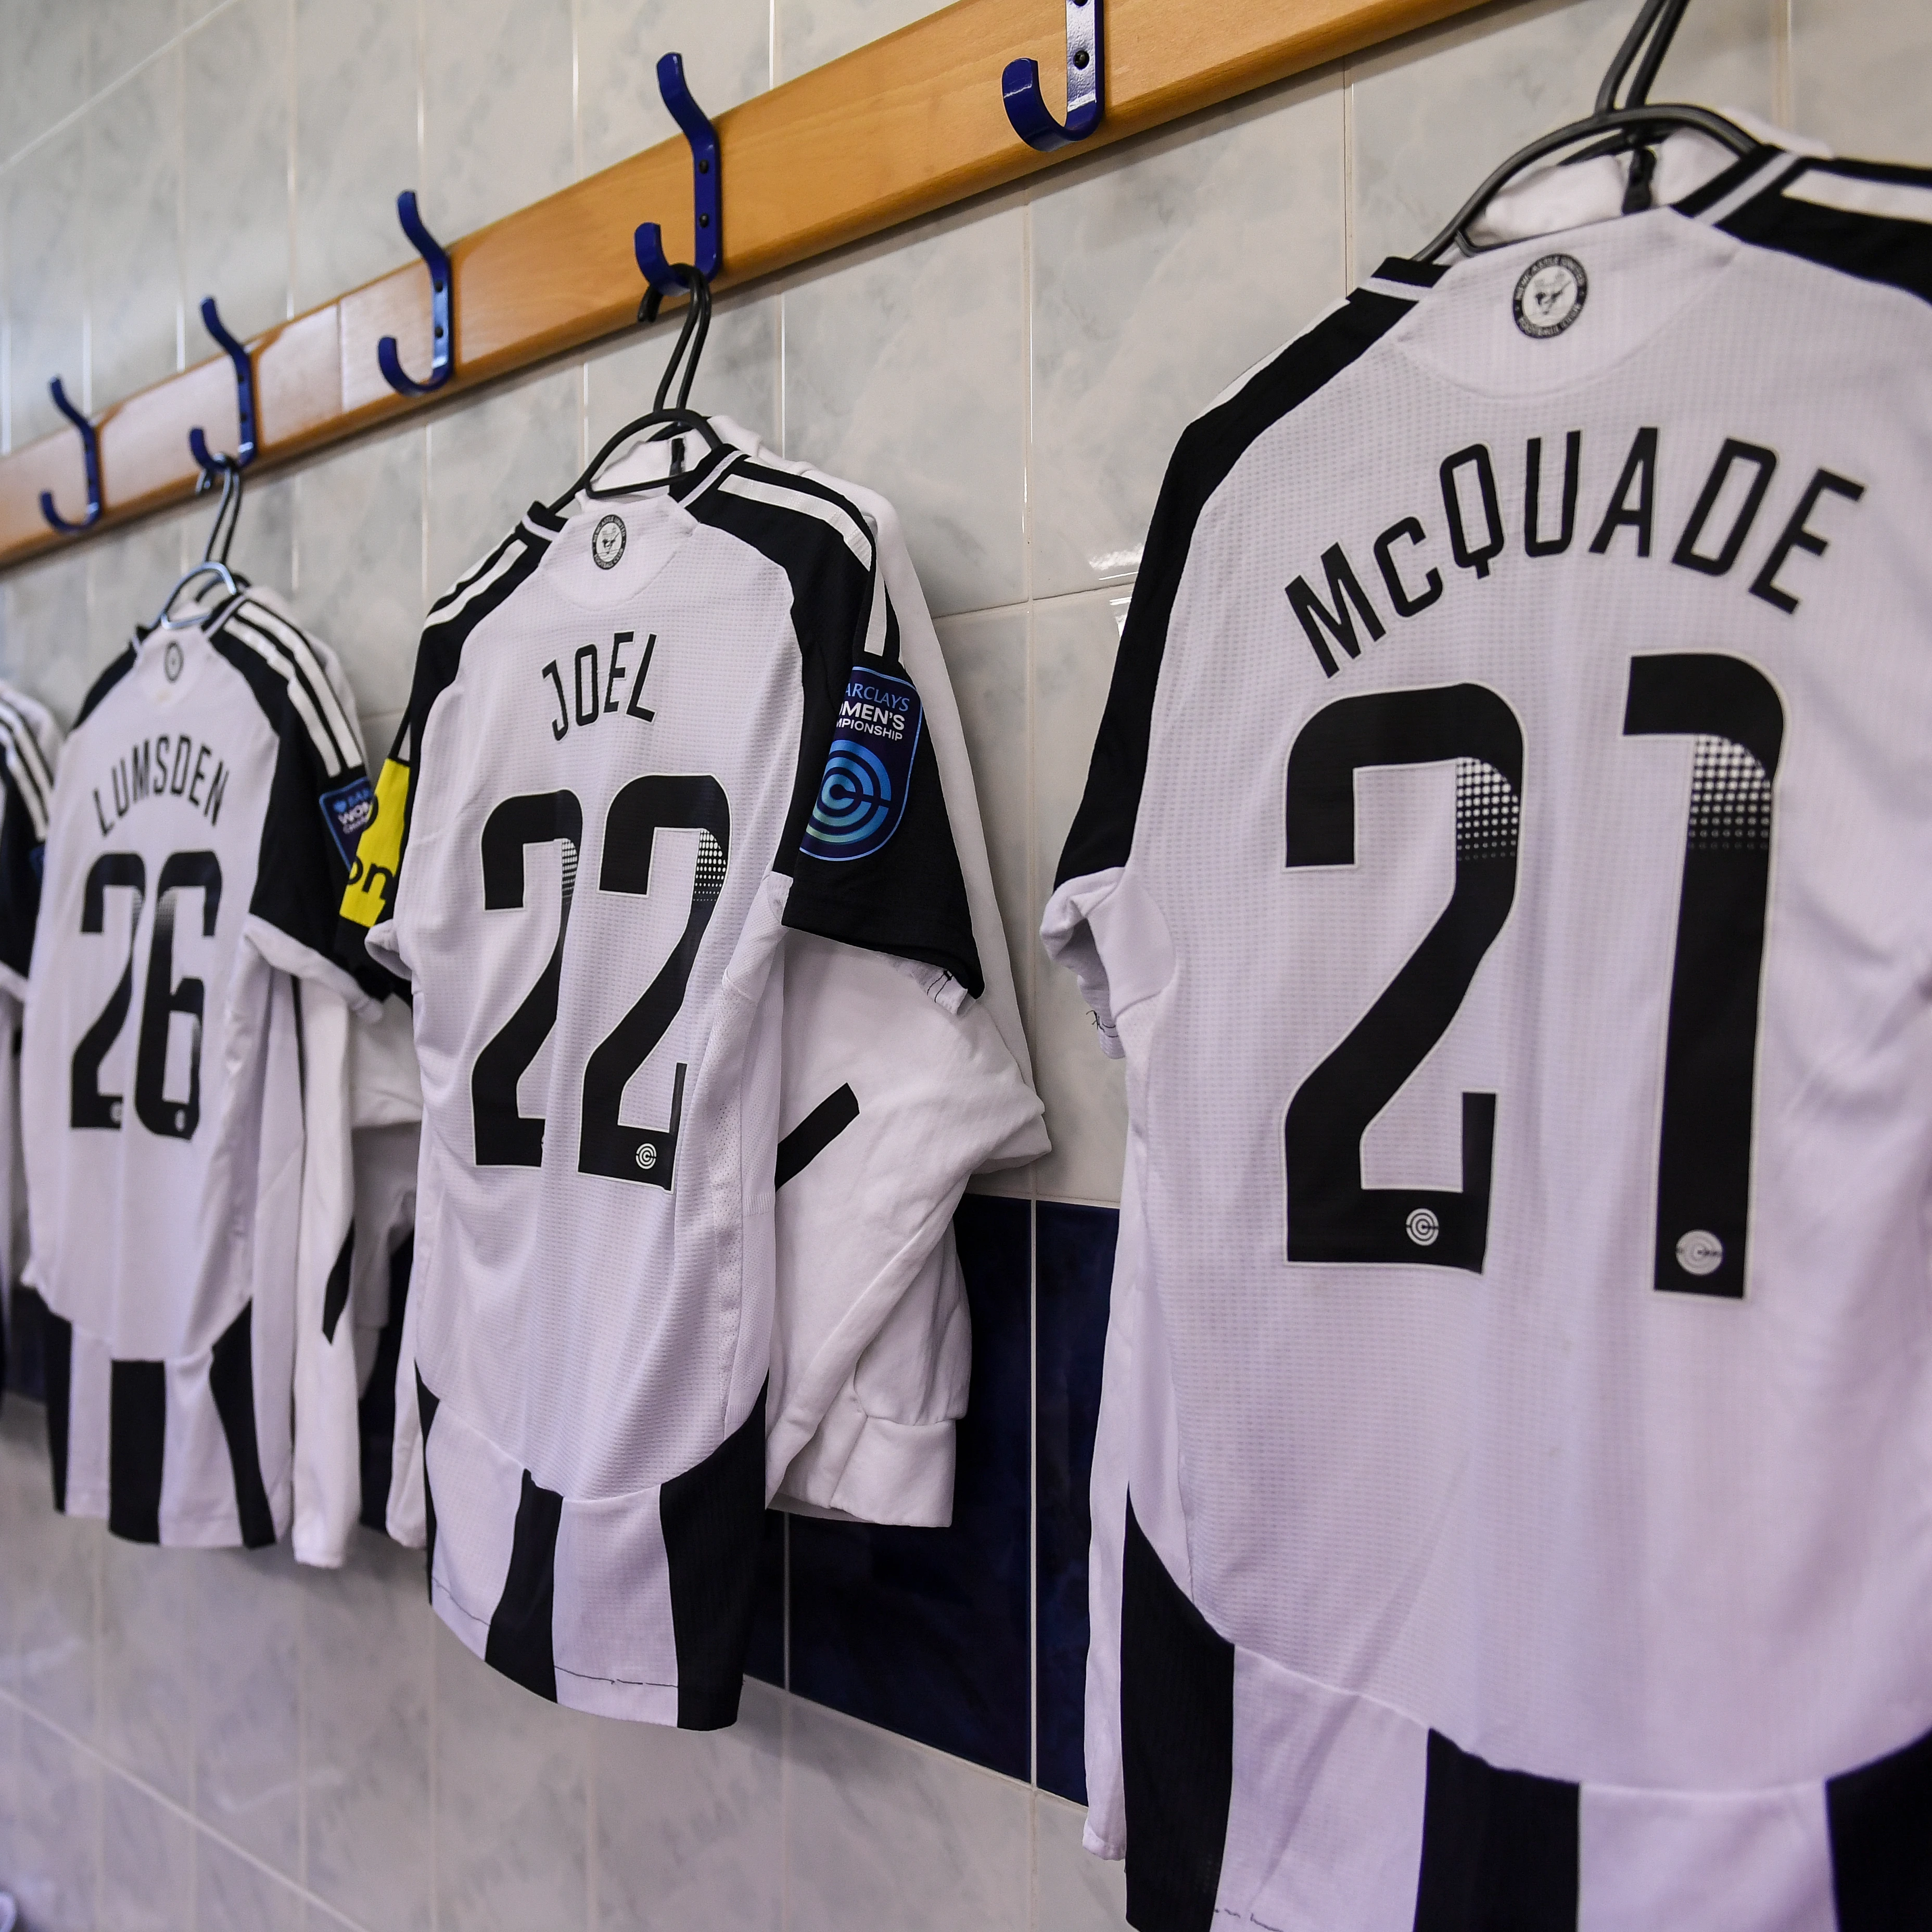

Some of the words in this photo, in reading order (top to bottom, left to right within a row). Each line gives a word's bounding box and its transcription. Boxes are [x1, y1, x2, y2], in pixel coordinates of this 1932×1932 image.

[93, 733, 230, 837] LUMSDEN
[541, 630, 657, 742] JOEL
[839, 701, 905, 730] MEN'S
[68, 849, 223, 1143] 26
[471, 774, 731, 1191] 22
[1284, 652, 1786, 1301] 21
